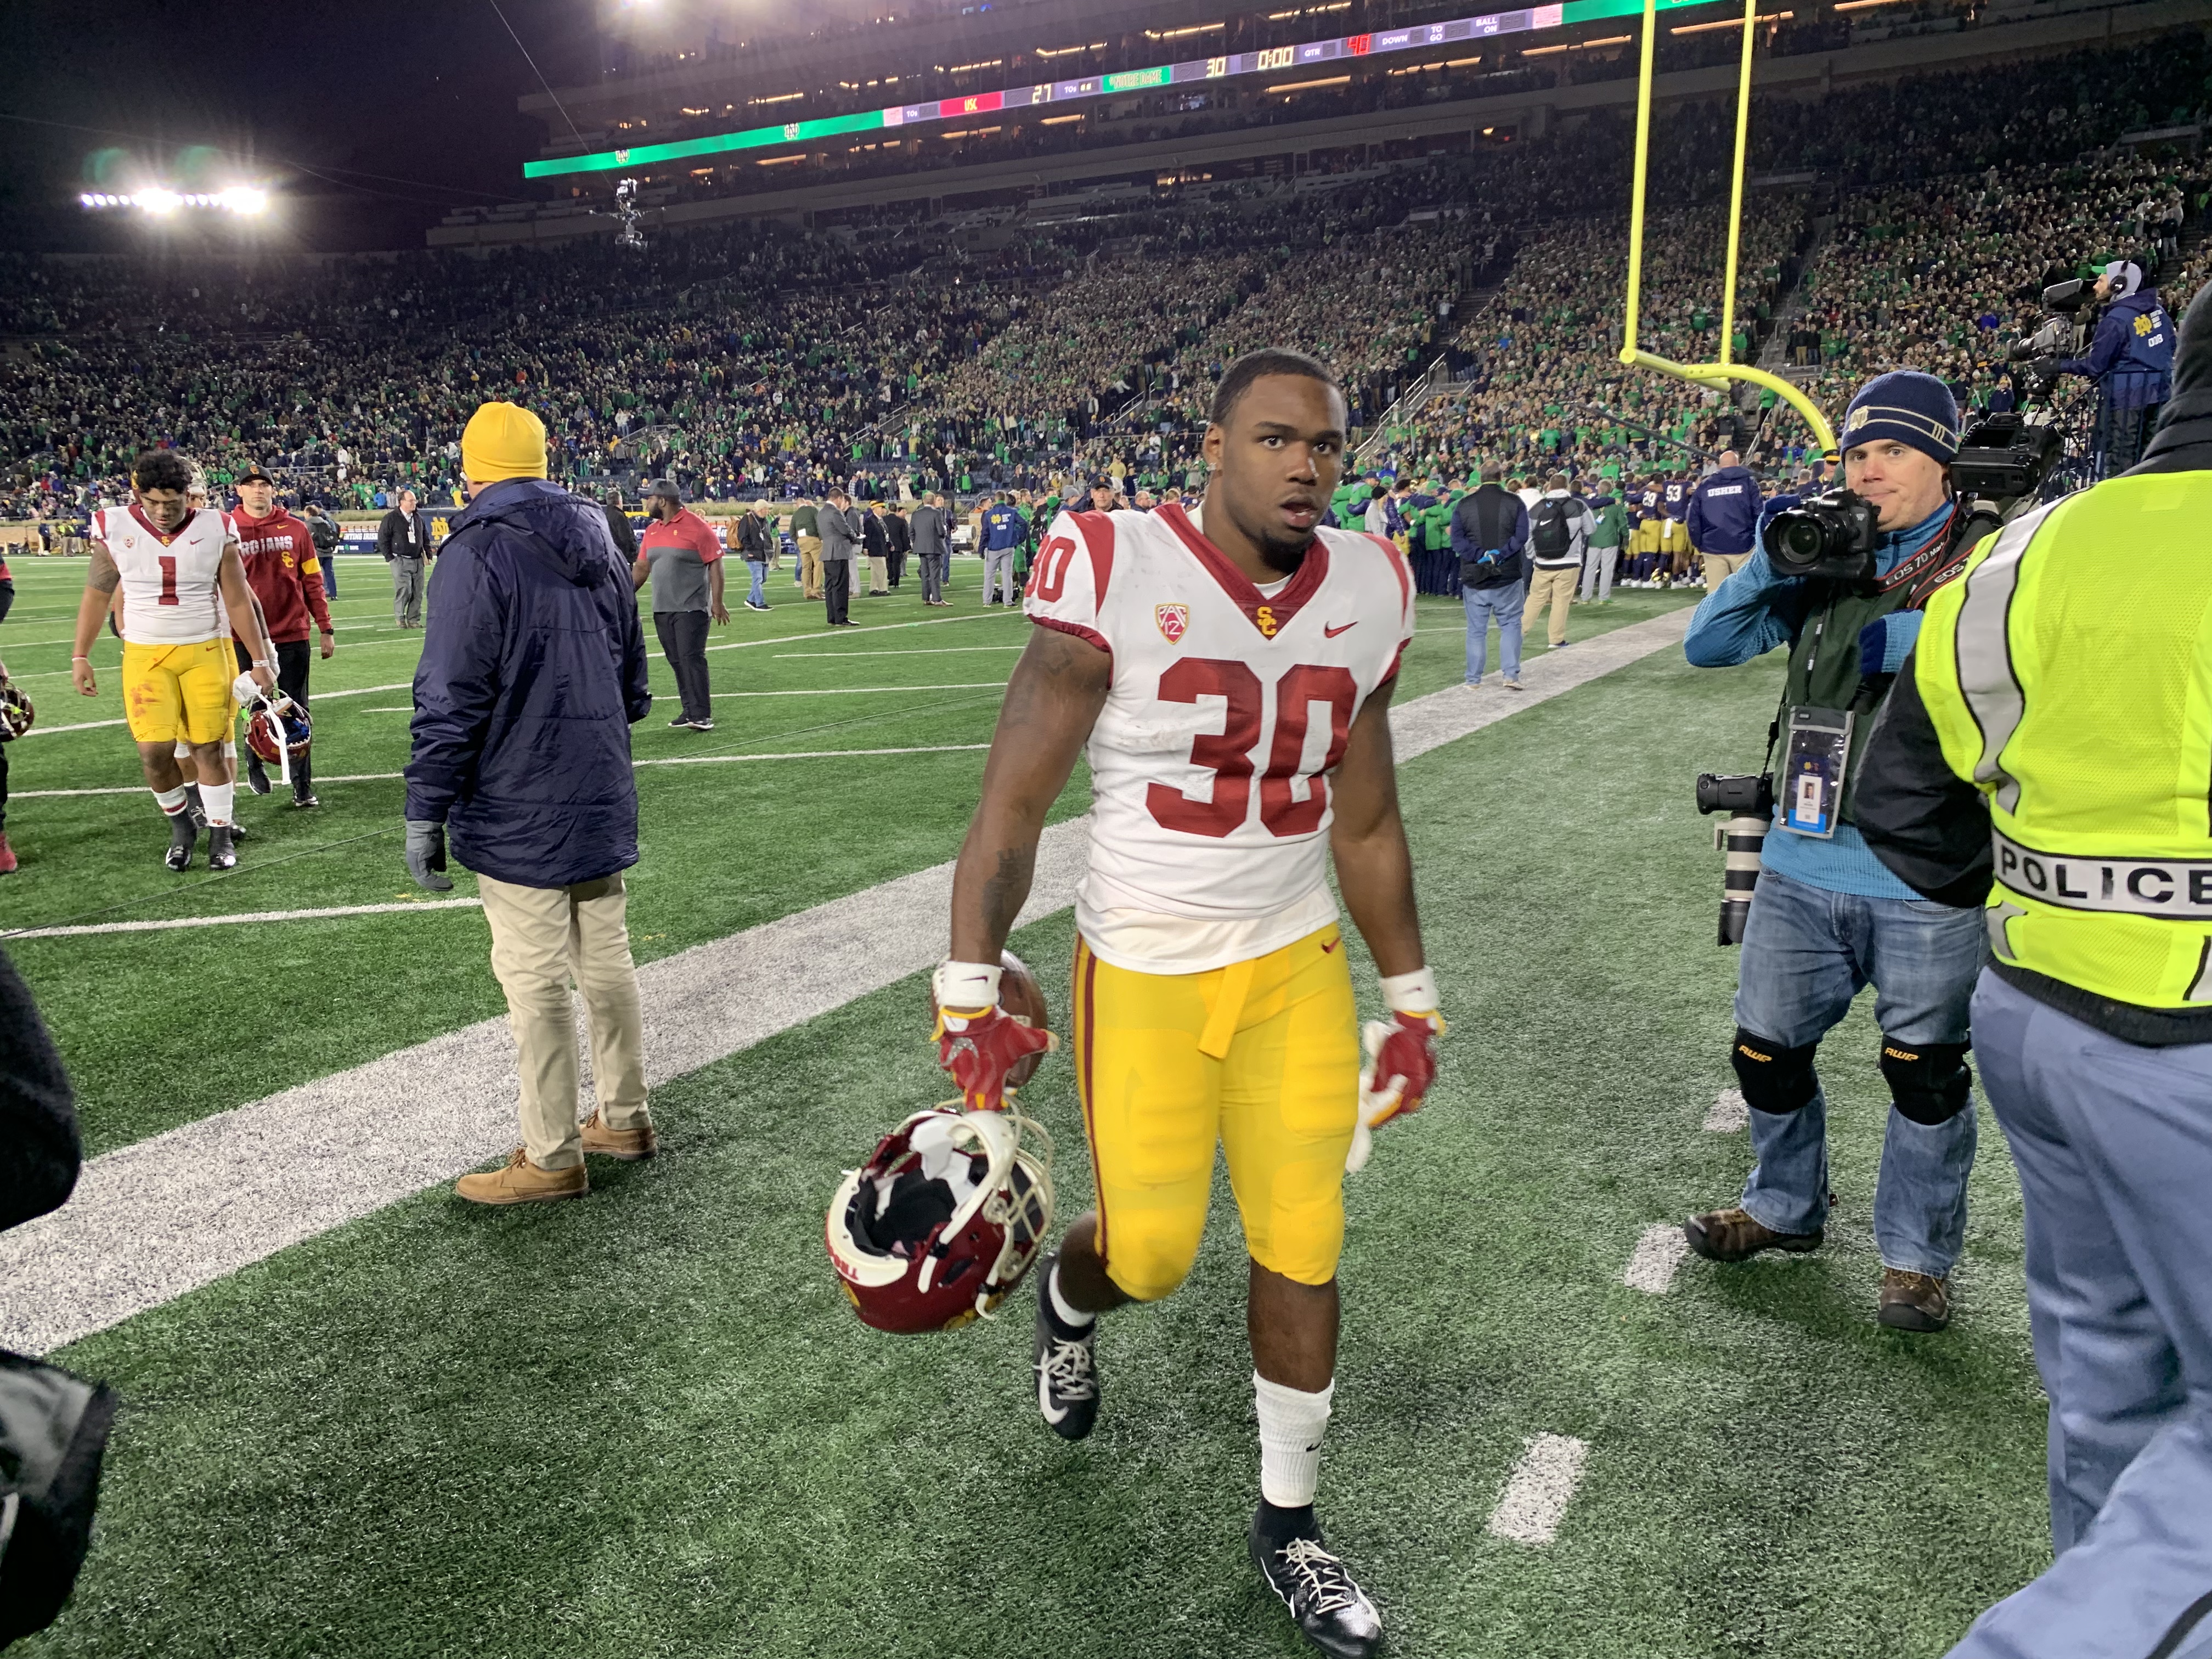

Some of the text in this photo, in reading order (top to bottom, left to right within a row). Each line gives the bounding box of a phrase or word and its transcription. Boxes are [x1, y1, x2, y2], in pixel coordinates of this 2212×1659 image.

[1476, 17, 1497, 27] BALL
[1484, 25, 1497, 33] ON
[1347, 34, 1371, 55] 40
[1382, 34, 1408, 46] DOWN
[1430, 33, 1443, 42] GO
[1257, 46, 1295, 70] 0:00
[1305, 48, 1321, 57] QTR
[1206, 57, 1227, 78] 30
[1114, 72, 1139, 89] NOTRE
[1139, 69, 1162, 86] DAME
[1032, 84, 1052, 104] 27
[1064, 85, 1077, 94] TOs
[964, 98, 978, 111] USC
[1642, 490, 1658, 507] 29
[1666, 484, 1682, 501] 53
[1707, 485, 1743, 497] USHER
[241, 535, 294, 557] ROJANS
[1915, 552, 1928, 568] 7D
[159, 556, 179, 605] 1
[1934, 563, 1965, 583] EOS
[1164, 620, 1181, 635] 12
[1257, 606, 1277, 635] SC
[1146, 657, 1357, 838] 30
[2000, 844, 2212, 905] POLICE
[1739, 1045, 1772, 1063] AWP
[1884, 1047, 1919, 1062] AWP
